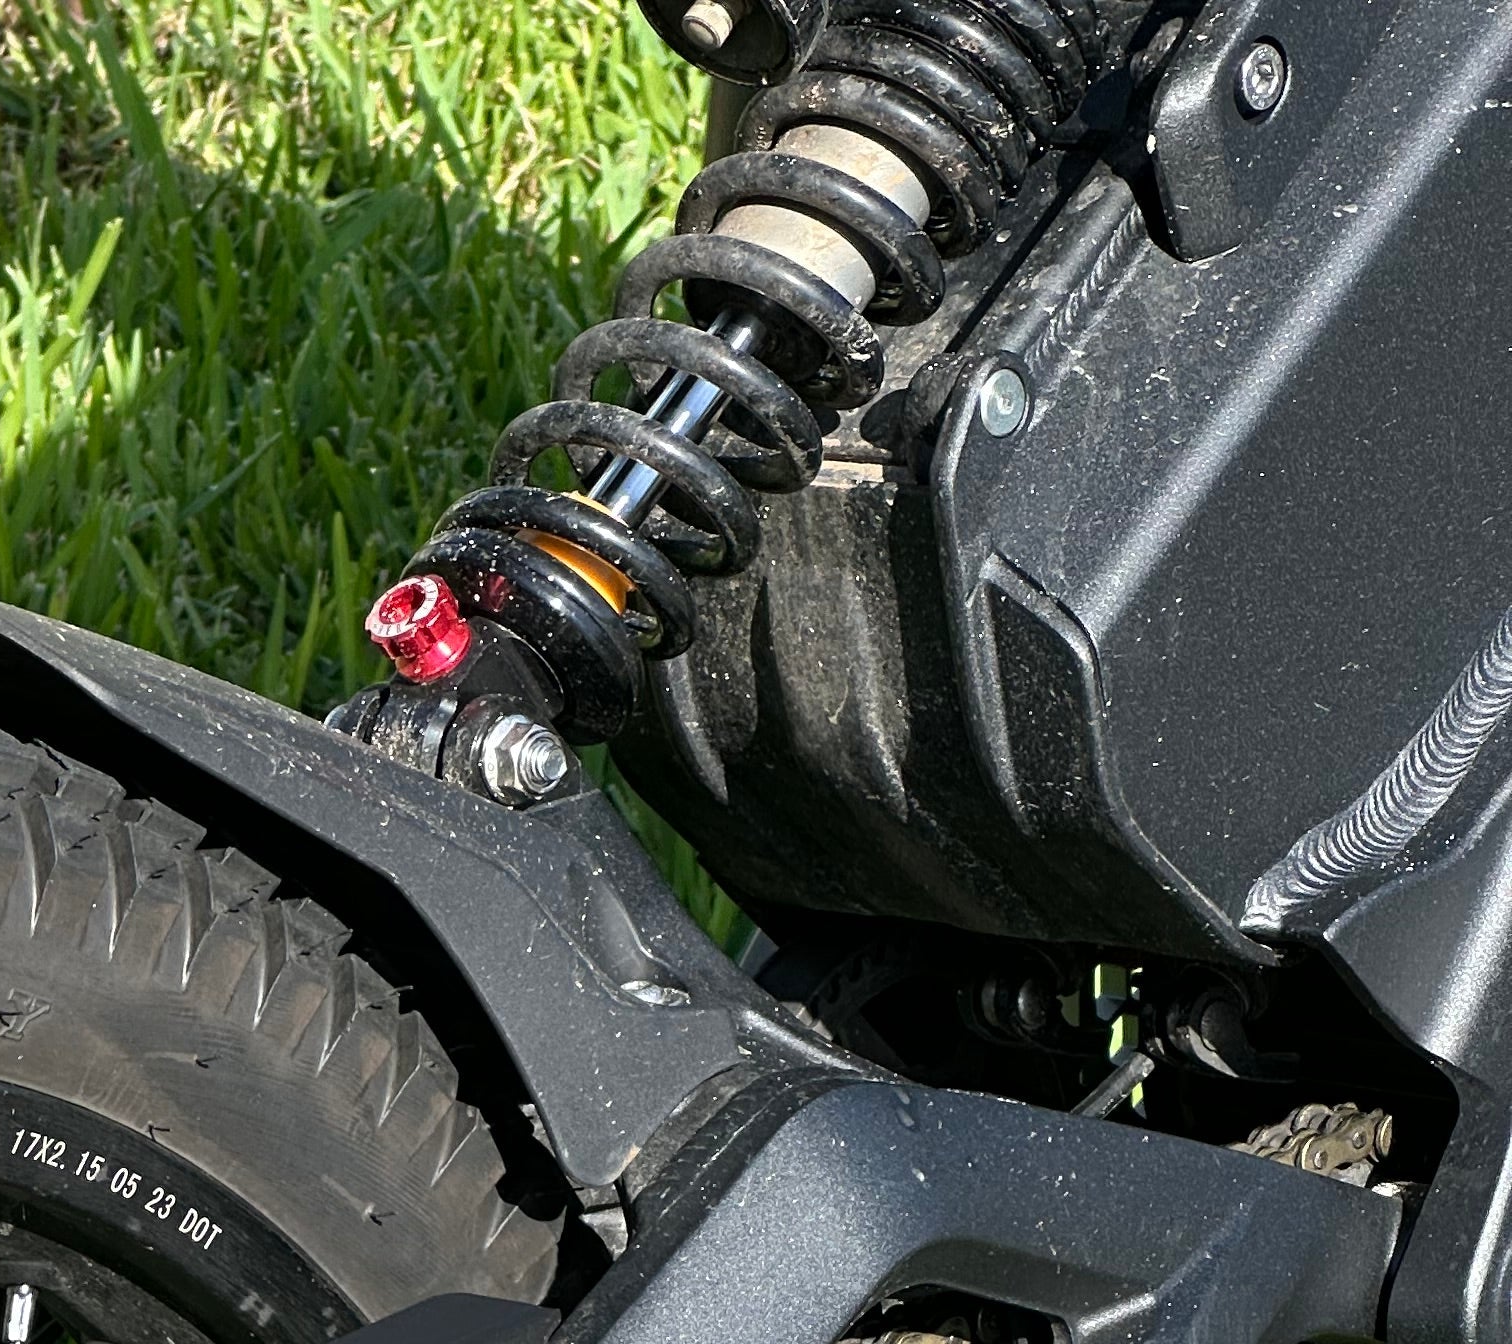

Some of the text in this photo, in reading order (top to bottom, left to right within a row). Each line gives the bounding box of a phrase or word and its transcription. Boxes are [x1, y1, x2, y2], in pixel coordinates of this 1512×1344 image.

[110, 1167, 142, 1199] 05
[144, 1186, 177, 1220] 23
[178, 1207, 223, 1250] DOT
